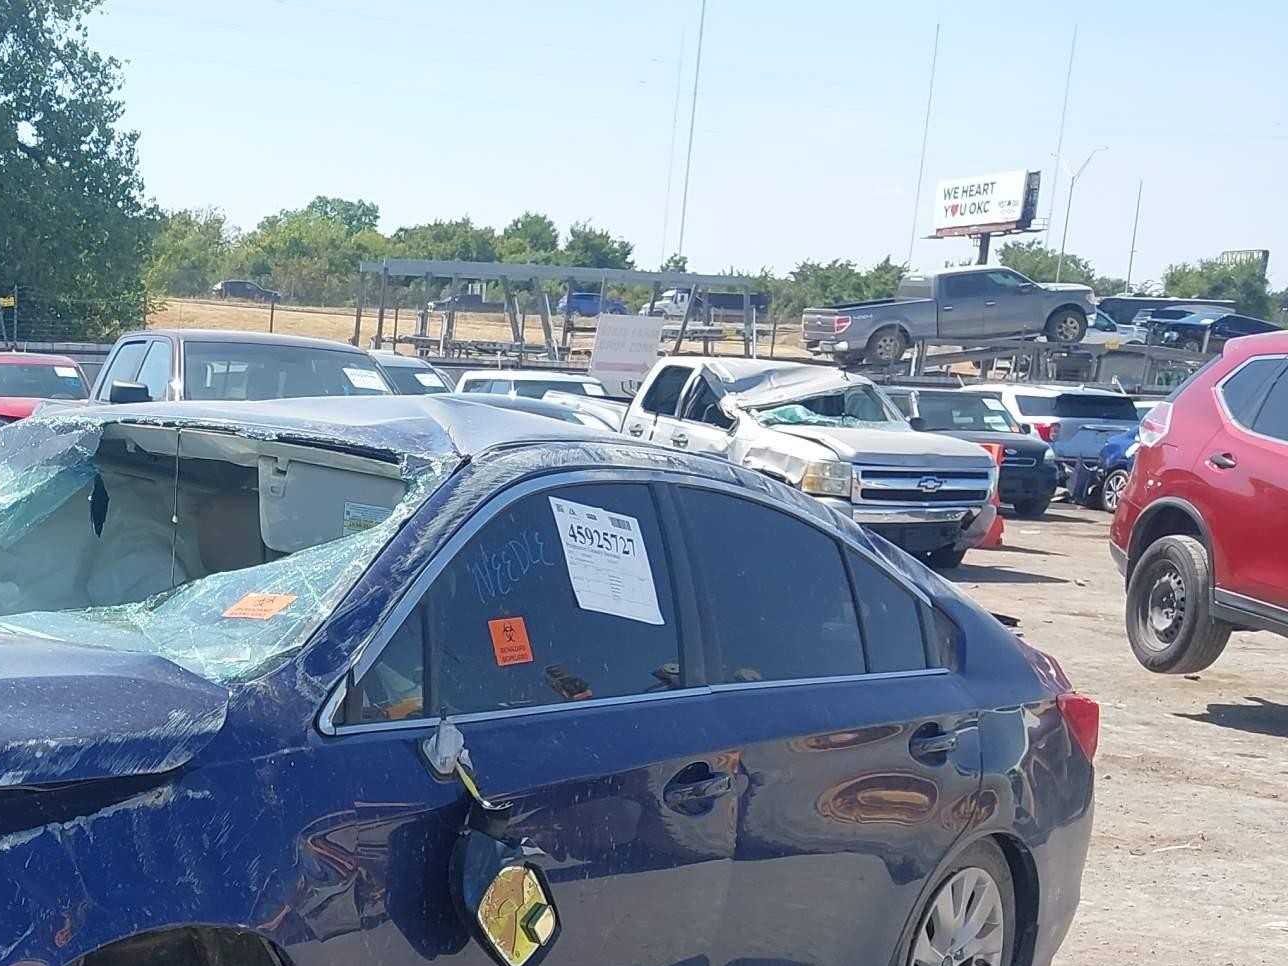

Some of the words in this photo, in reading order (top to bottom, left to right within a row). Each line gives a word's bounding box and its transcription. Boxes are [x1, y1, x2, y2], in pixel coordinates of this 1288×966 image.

[943, 185, 959, 200] WE
[961, 181, 996, 198] HEART
[969, 200, 991, 215] OKC
[568, 523, 636, 558] 45925727
